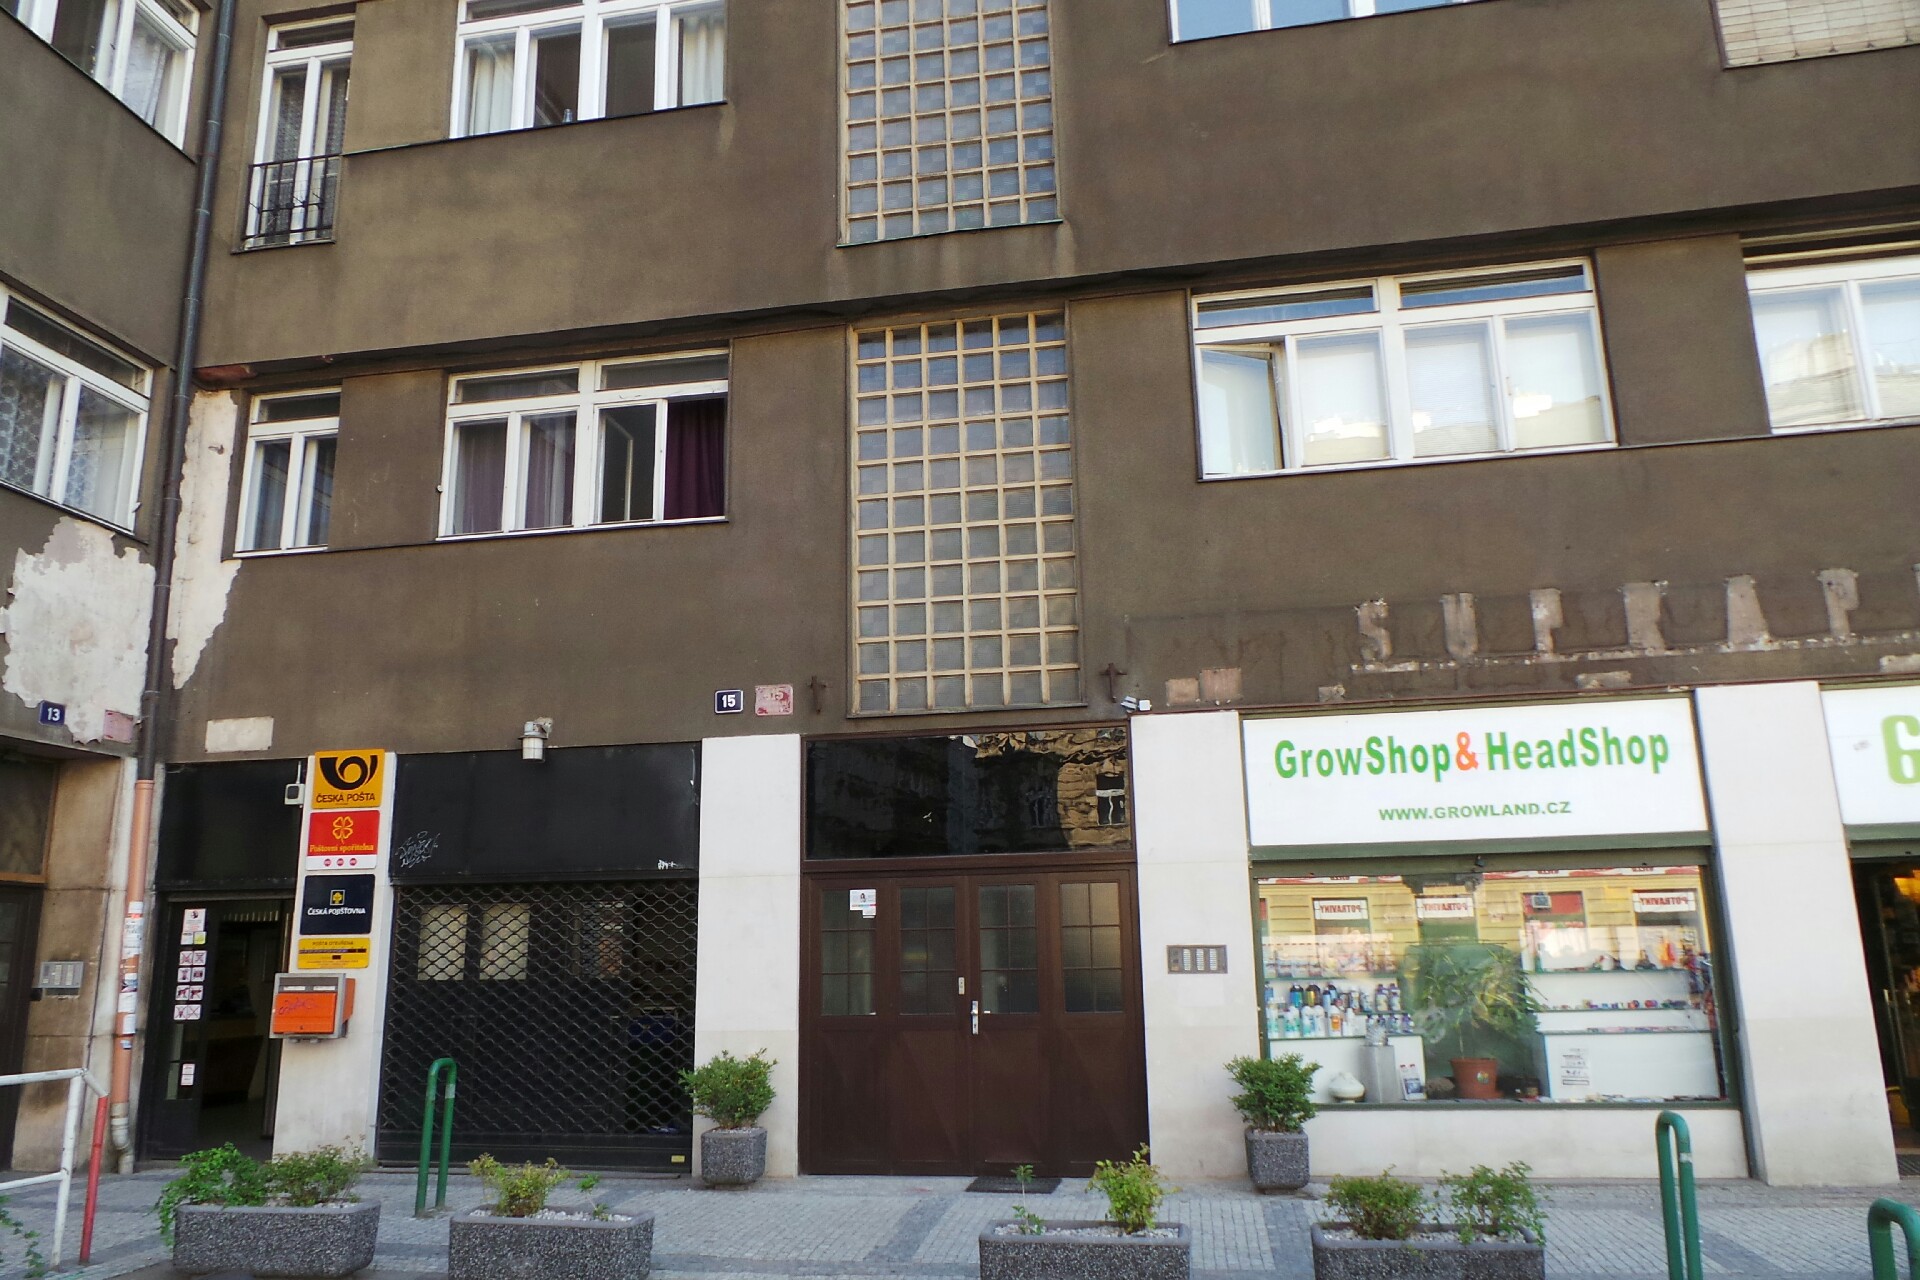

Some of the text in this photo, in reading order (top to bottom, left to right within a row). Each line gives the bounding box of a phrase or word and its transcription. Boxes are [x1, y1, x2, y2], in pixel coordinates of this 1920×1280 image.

[721, 694, 736, 708] 15
[47, 707, 61, 721] 13
[1274, 726, 1671, 782] GrowShop & HeadShop
[316, 791, 376, 803] ČESKÁ POŠTA
[1378, 801, 1572, 821] WWW.GROWLAND.CZ
[307, 906, 328, 916] ČESKÁ
